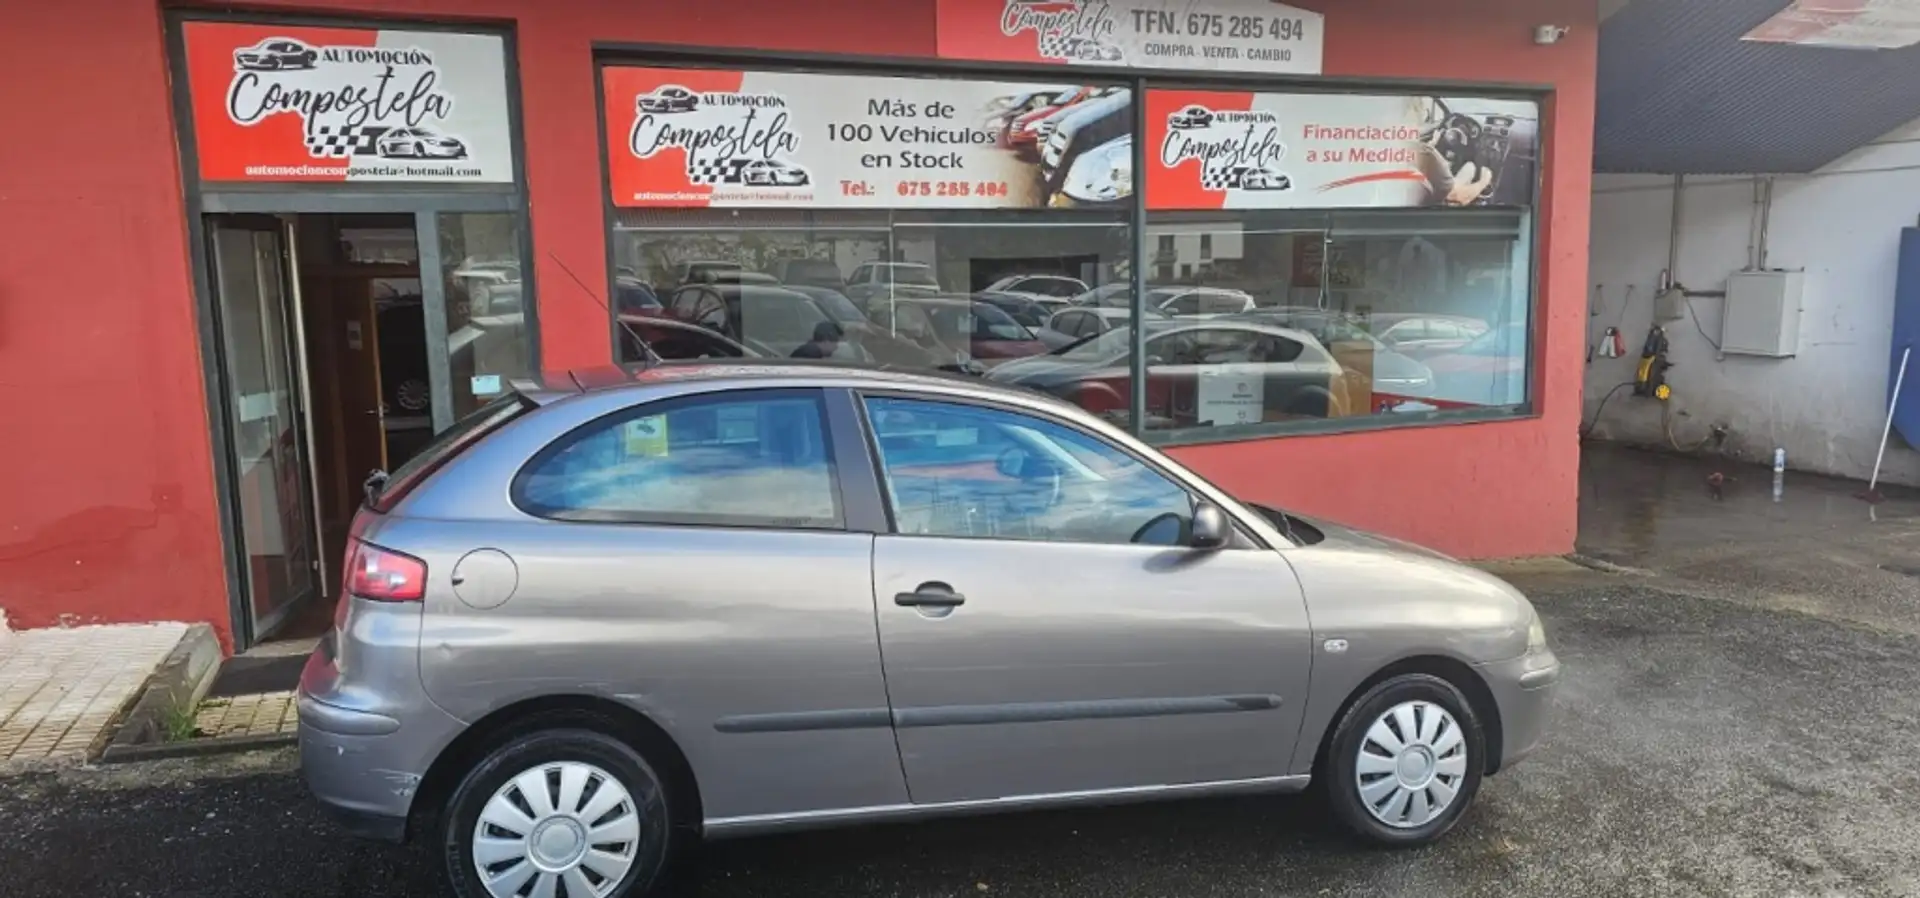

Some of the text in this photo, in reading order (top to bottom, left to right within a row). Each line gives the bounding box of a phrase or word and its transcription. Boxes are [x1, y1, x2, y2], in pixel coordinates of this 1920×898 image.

[1131, 9, 1304, 41] TFN. 675 285 494
[321, 48, 433, 66] AUTOMOCIÓN
[1145, 43, 1195, 57] COMPRA
[1202, 45, 1239, 59] VENTA
[1247, 47, 1292, 62] CAMBIO
[229, 66, 451, 135] Compostela
[702, 93, 786, 108] AUTOMOCIÓN
[868, 99, 956, 119] Más de
[632, 108, 799, 167] Compostela
[828, 123, 997, 145] 100 Vehículos
[1304, 124, 1420, 141] Financiación
[861, 151, 964, 169] en Stock
[1162, 123, 1285, 180] Compostela
[1306, 147, 1416, 163] a su Medida
